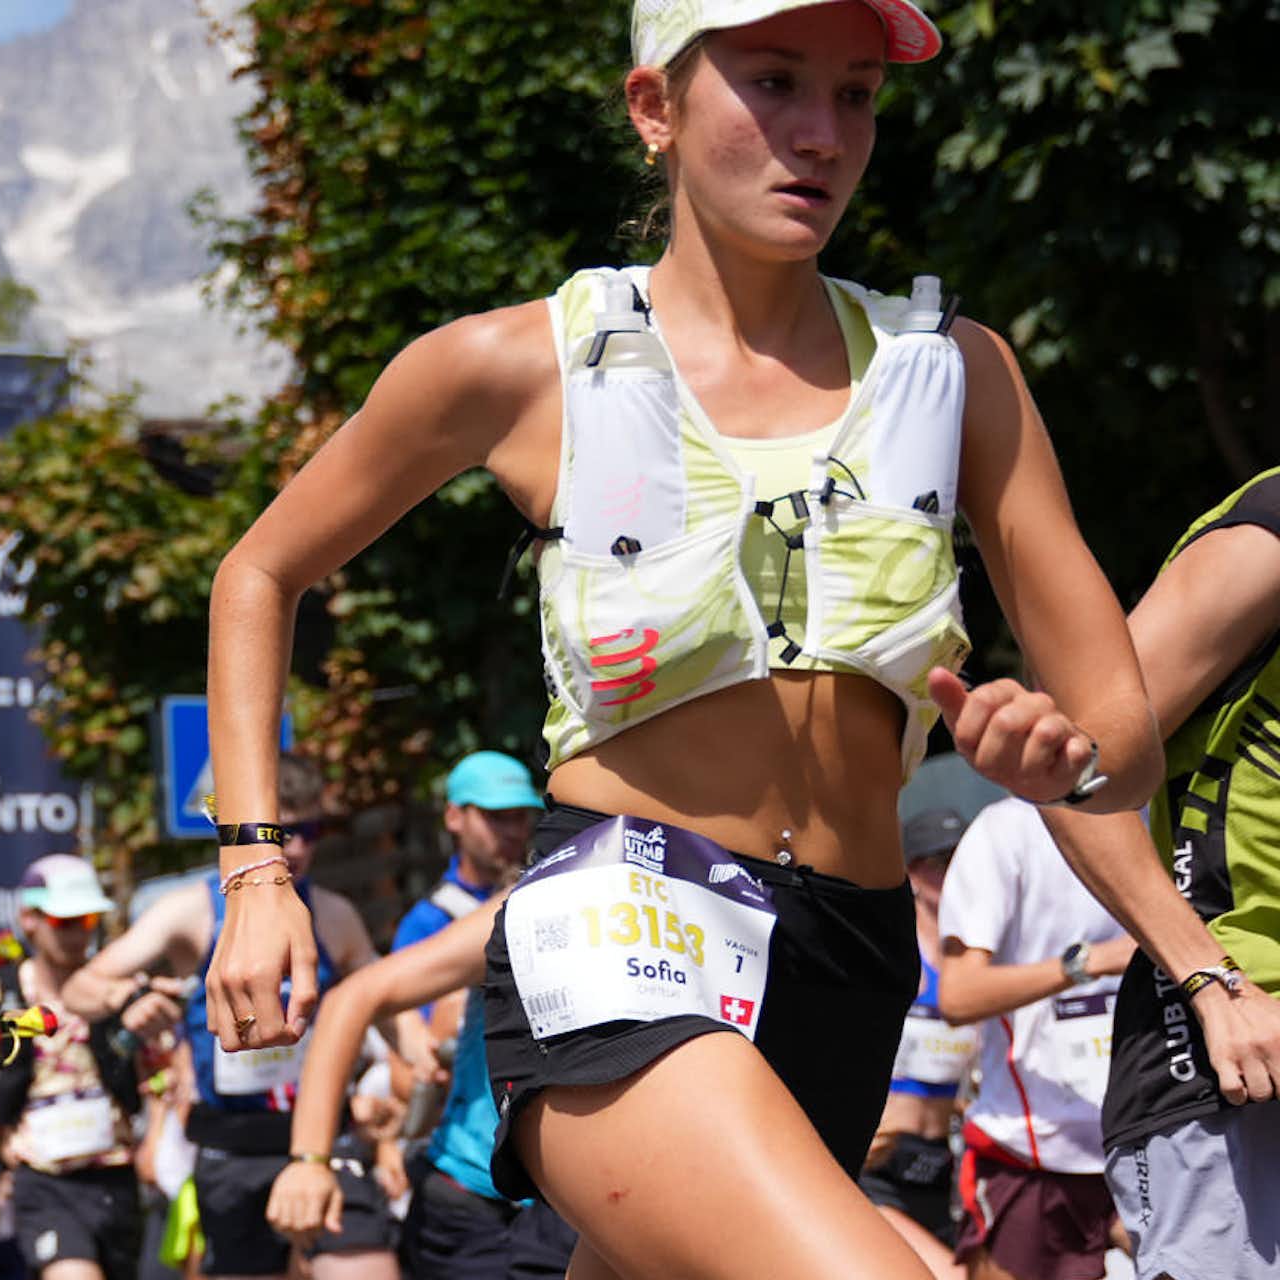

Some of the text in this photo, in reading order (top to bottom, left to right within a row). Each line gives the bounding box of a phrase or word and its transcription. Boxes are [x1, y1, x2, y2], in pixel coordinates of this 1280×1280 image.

[256, 827, 281, 842] ETC
[624, 837, 666, 862] UTMB
[628, 871, 669, 903] ETC
[580, 901, 706, 968] 13153
[626, 956, 687, 985] Sofia
[735, 954, 744, 974] 1
[1164, 1001, 1197, 1083] CLUB
[1134, 1144, 1154, 1227] ERREX
